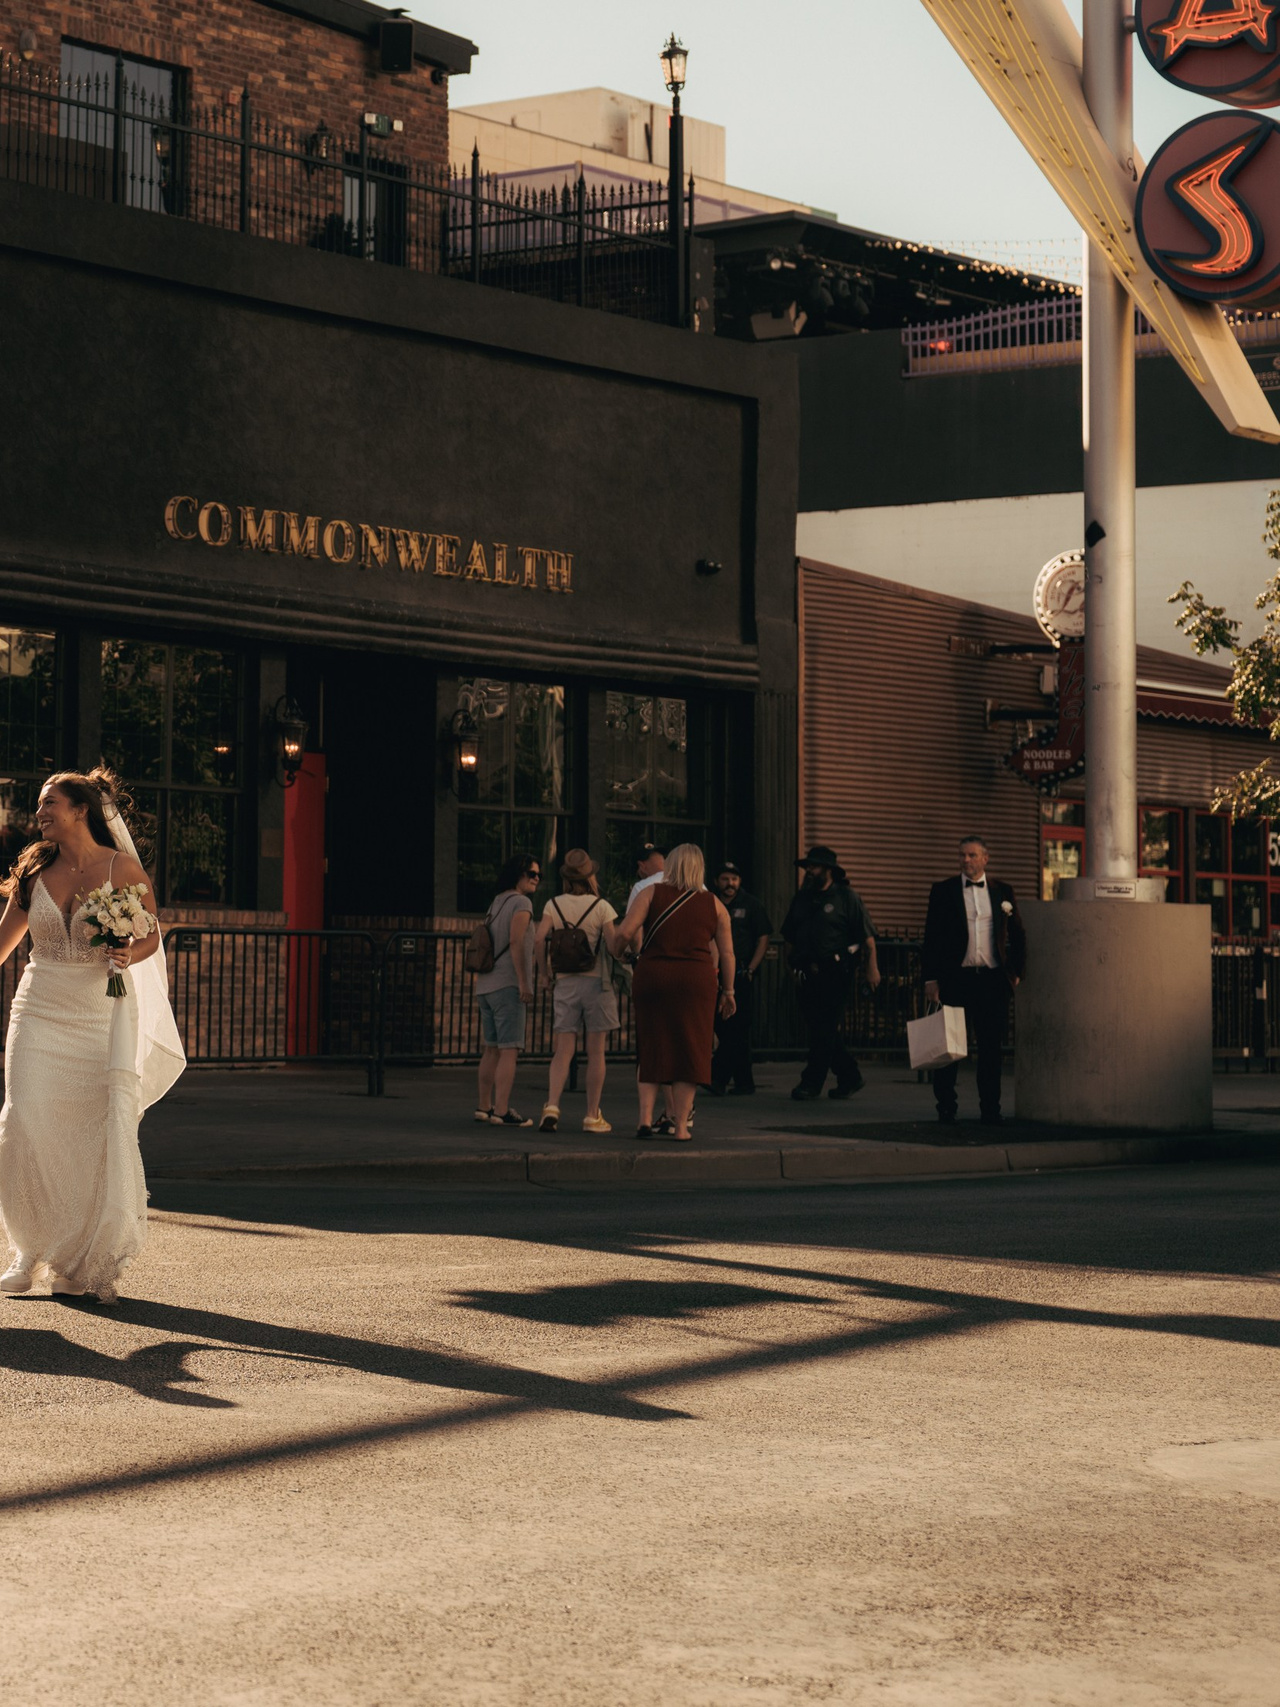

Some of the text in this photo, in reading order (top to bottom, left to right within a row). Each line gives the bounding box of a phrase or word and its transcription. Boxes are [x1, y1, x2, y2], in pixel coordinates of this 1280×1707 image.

[164, 496, 575, 593] COMMONWEALTH
[1023, 750, 1072, 760] NOODLES
[1023, 760, 1055, 770] & BAR
